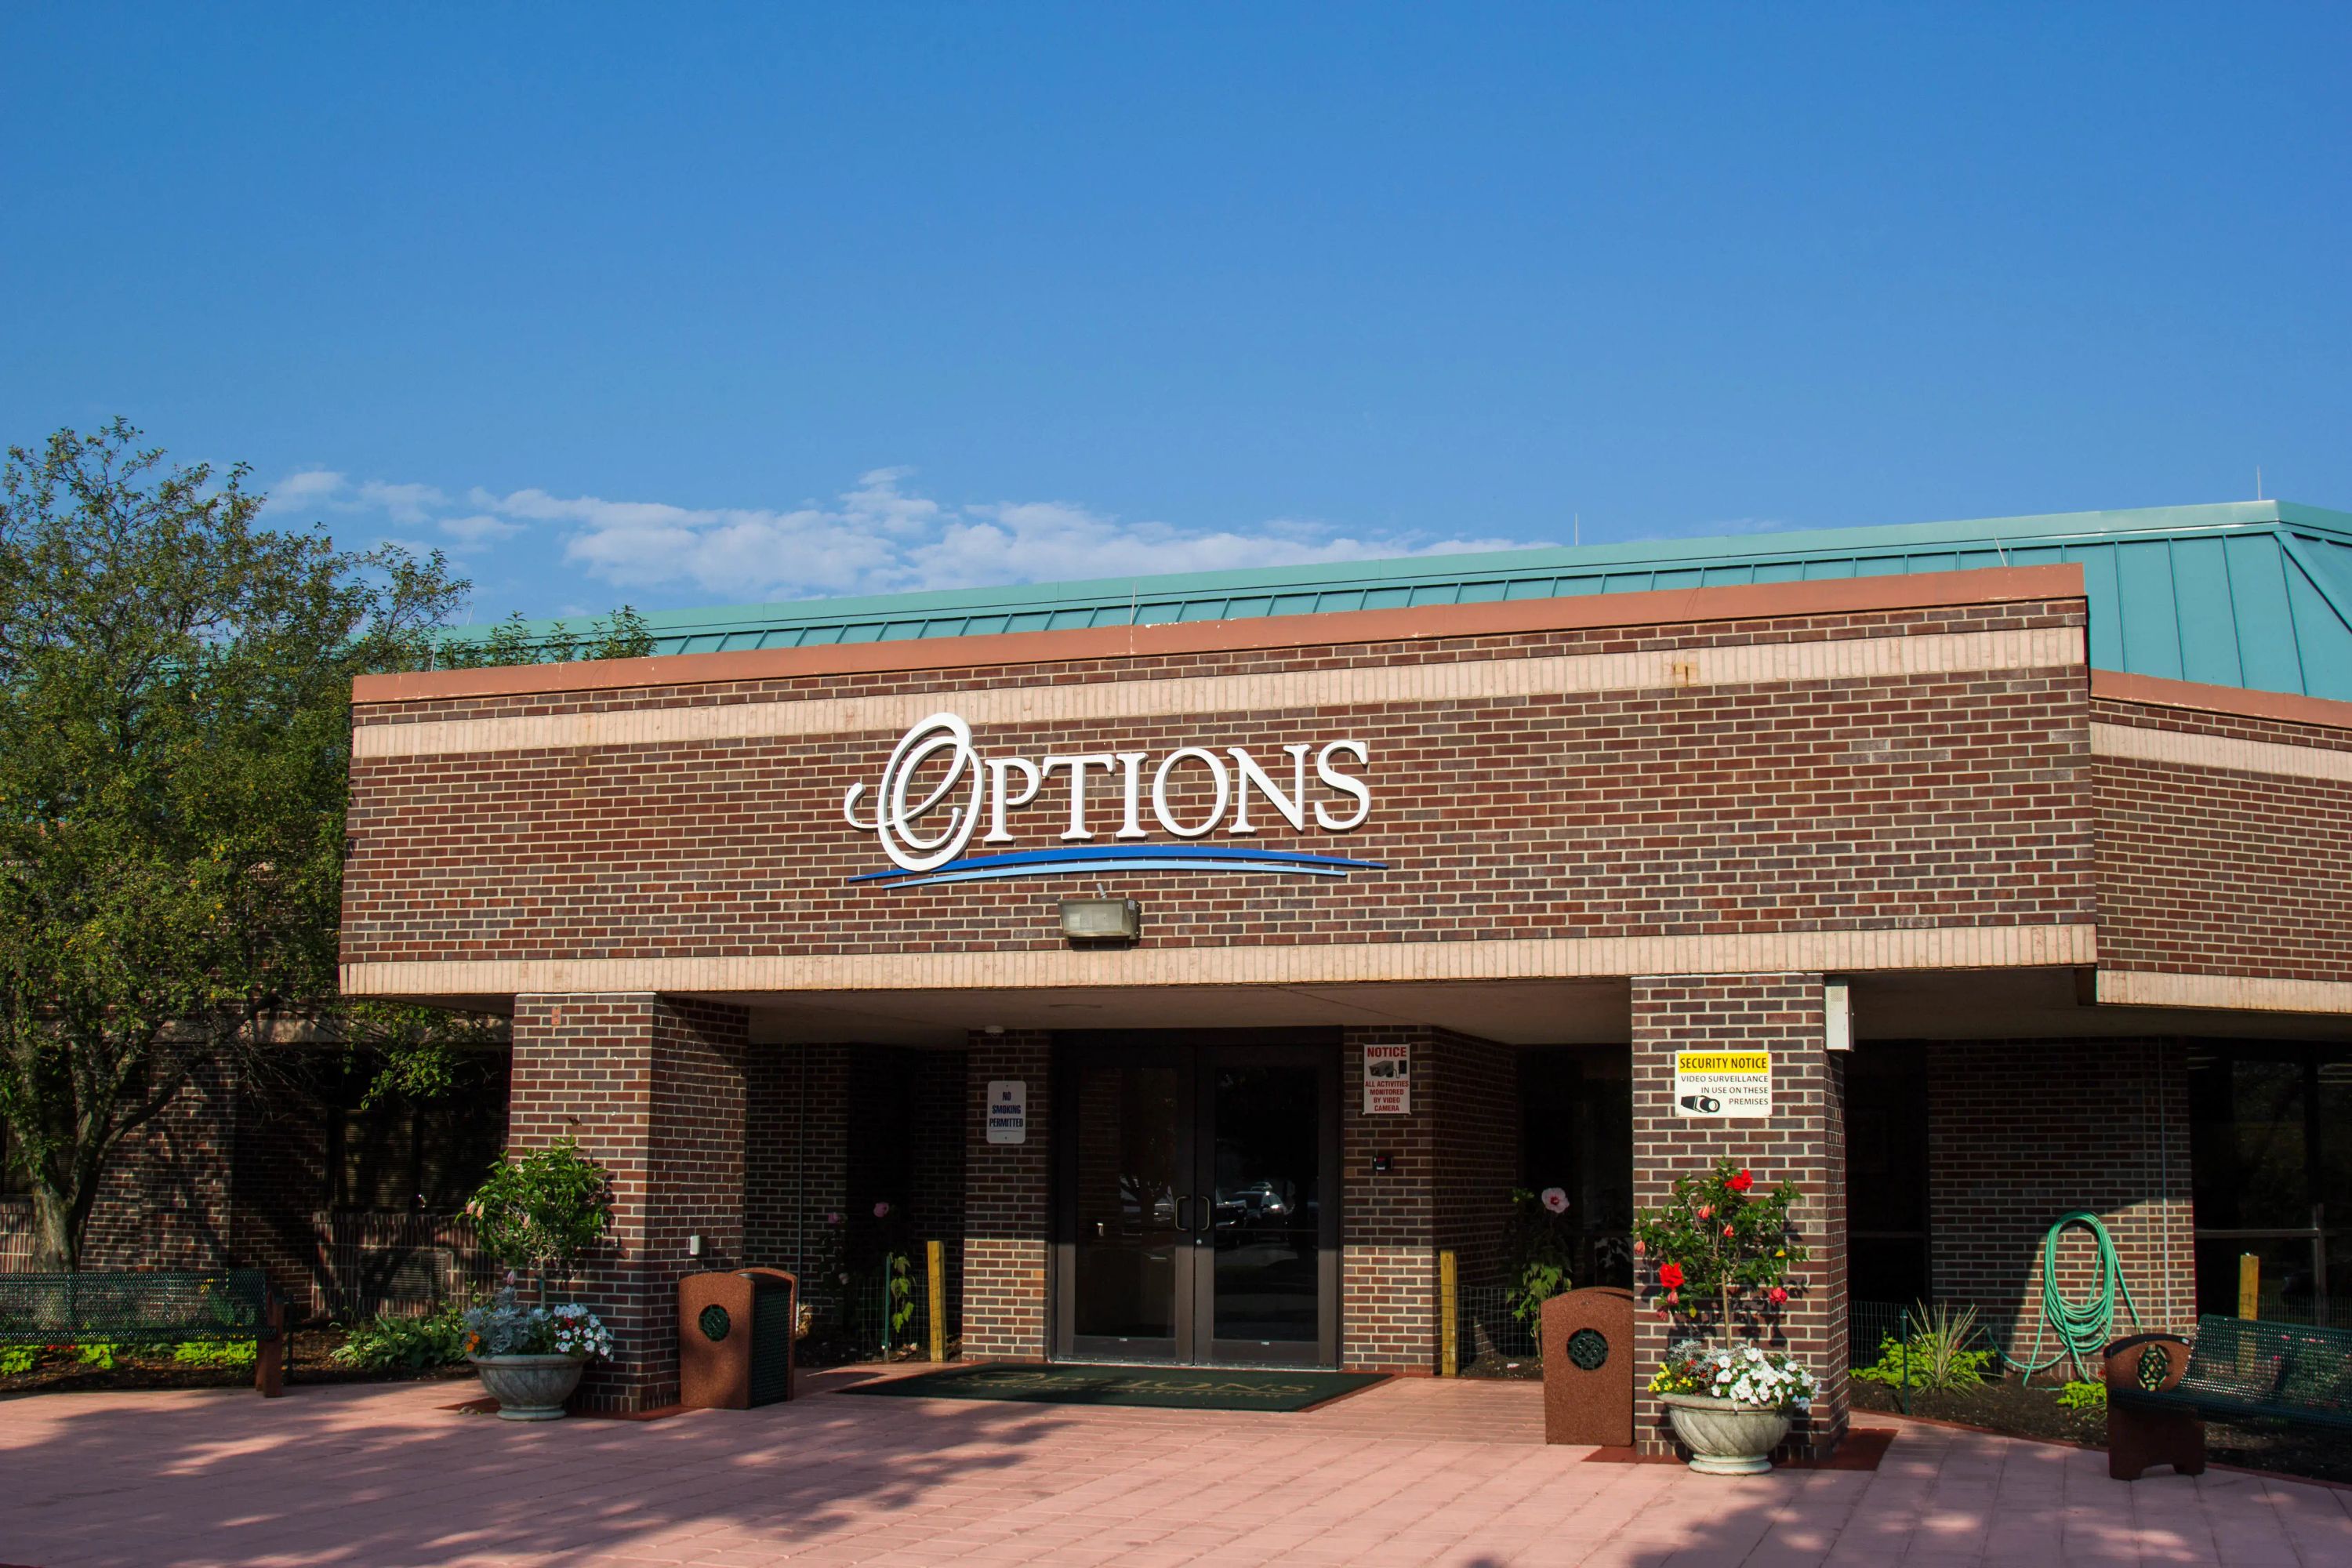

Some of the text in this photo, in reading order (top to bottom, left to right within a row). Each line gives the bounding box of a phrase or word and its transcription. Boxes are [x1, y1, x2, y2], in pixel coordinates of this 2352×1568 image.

[844, 712, 1371, 872] OPTIONS
[1367, 1047, 1406, 1058] NOTICE
[1680, 1058, 1767, 1069] SECURITY NOTICE
[1002, 1091, 1011, 1101] NO
[992, 1105, 1021, 1114] SMOKING
[989, 1118, 1023, 1127] PERMITTED
